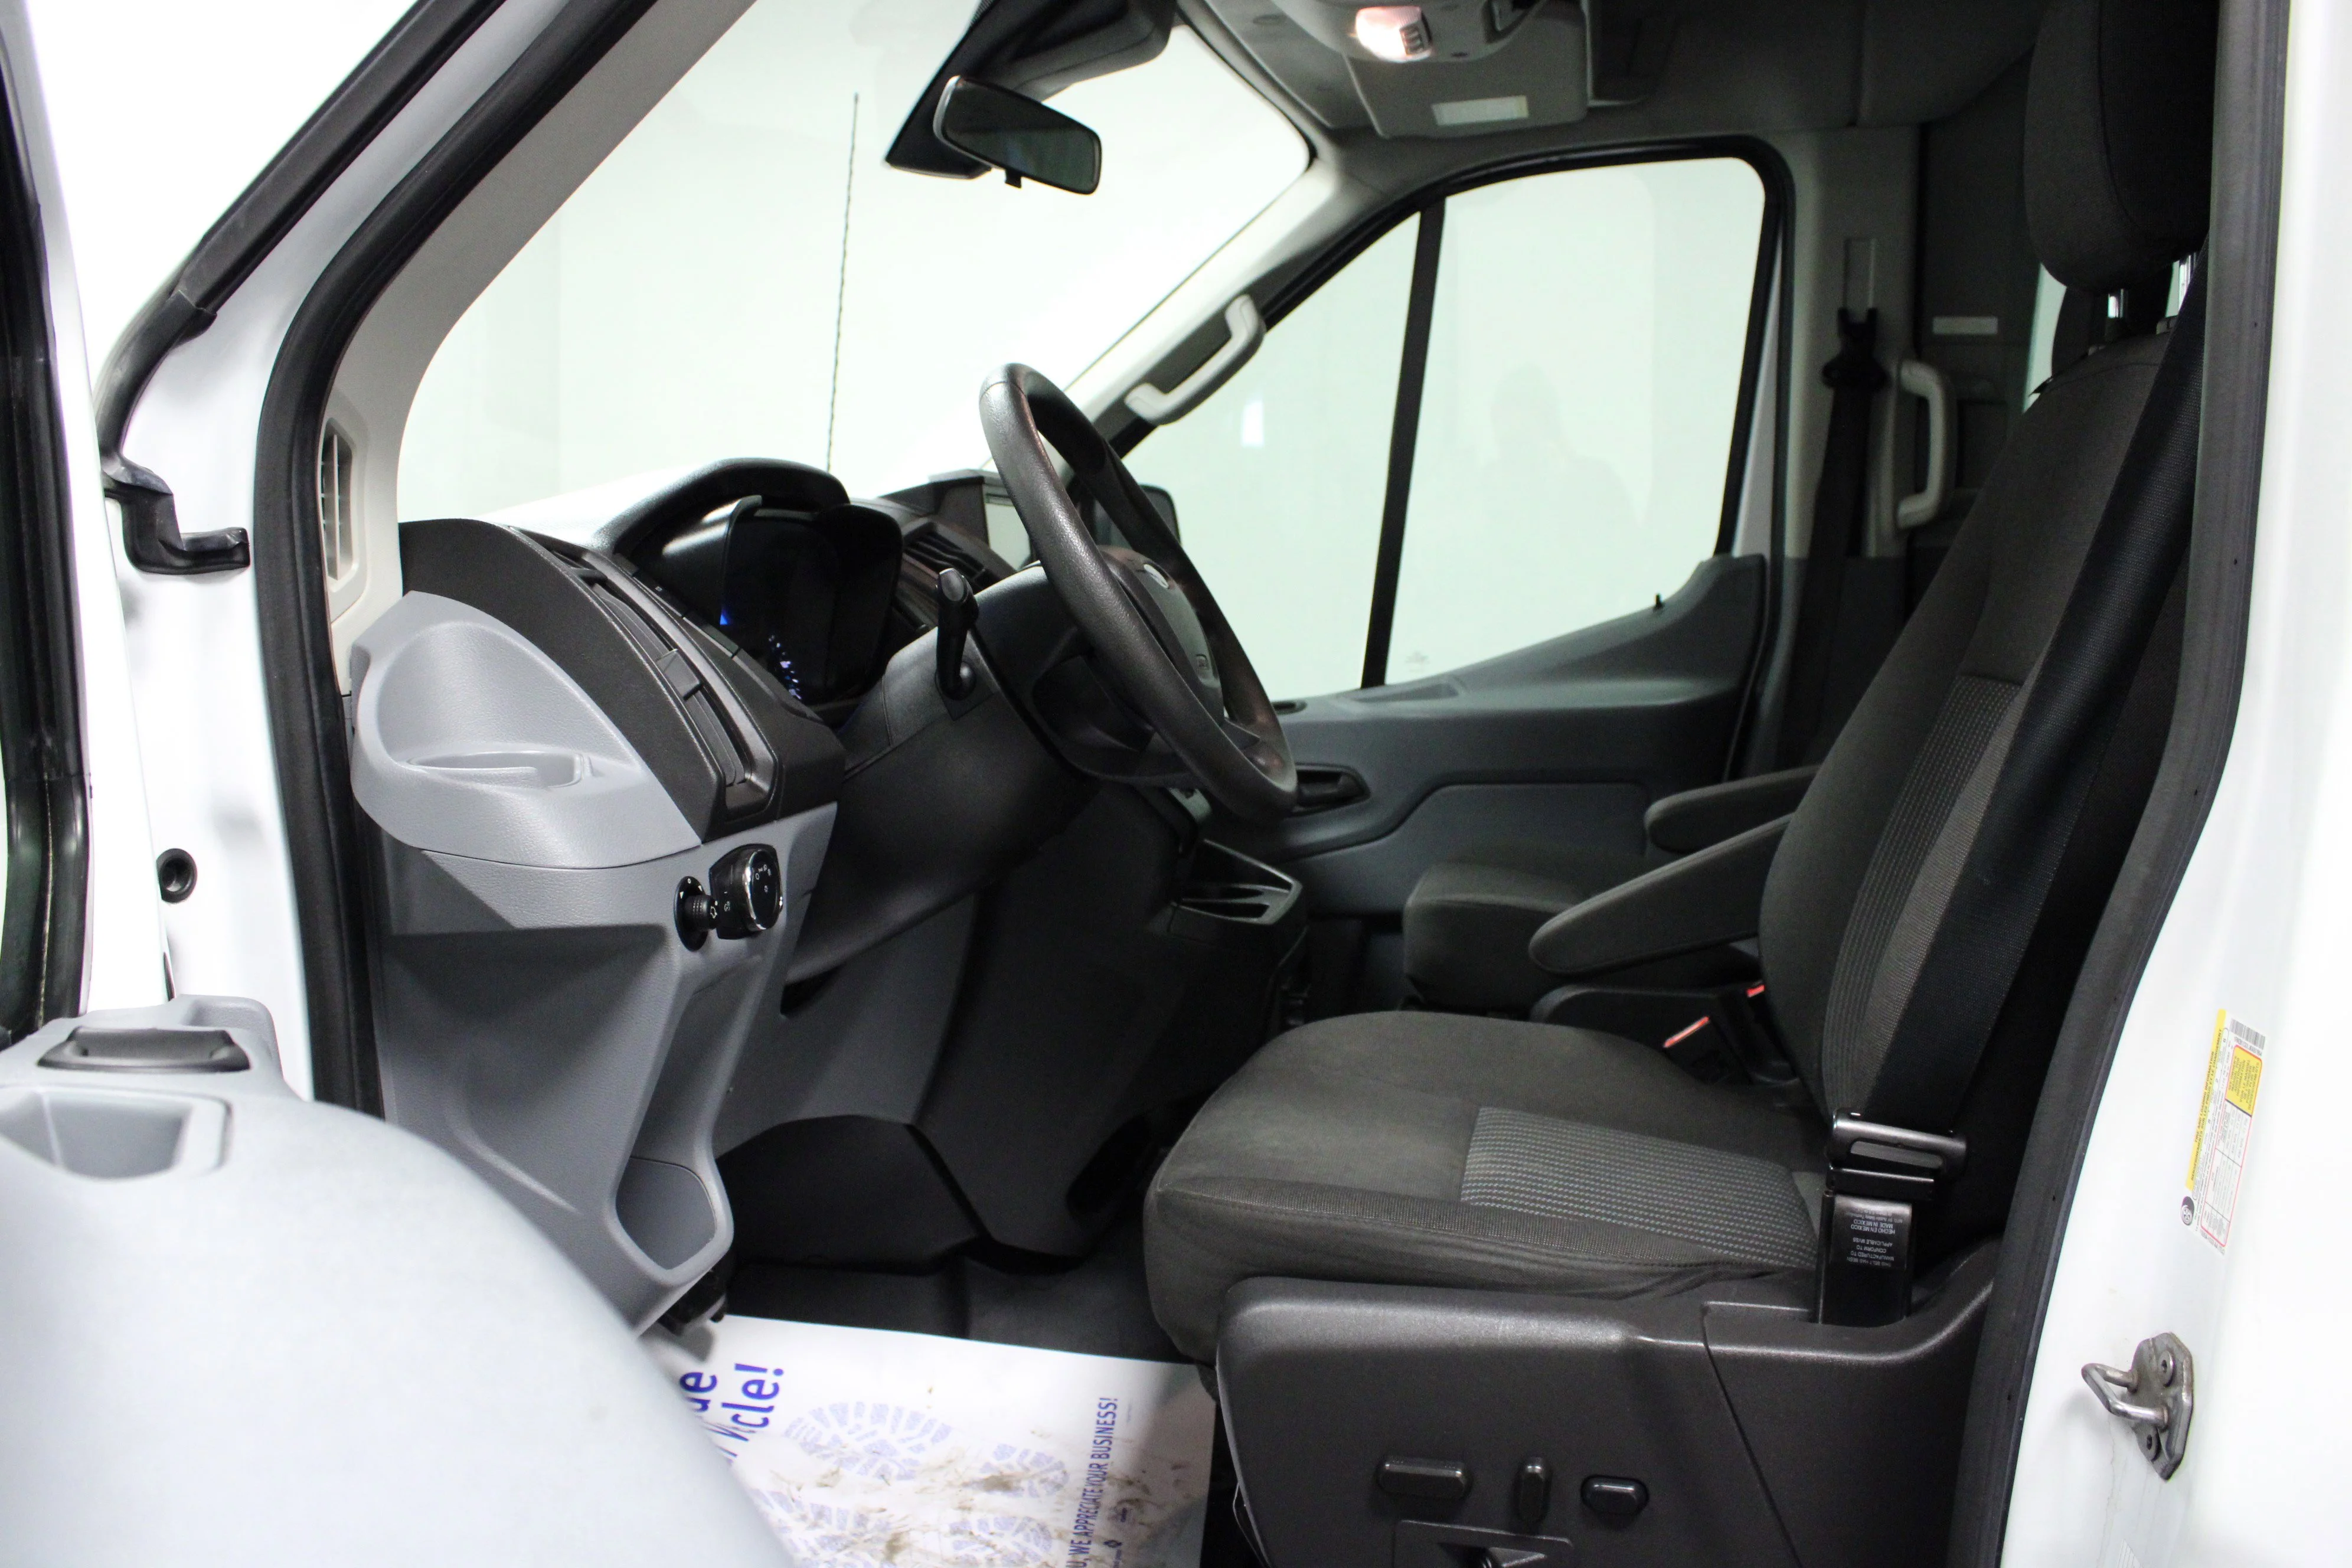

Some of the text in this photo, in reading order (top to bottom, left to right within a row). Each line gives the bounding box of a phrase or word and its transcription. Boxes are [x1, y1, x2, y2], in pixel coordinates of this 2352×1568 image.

[1090, 1397, 1118, 1459] BUSINESS!
[1084, 1463, 1109, 1486] YOUR
[1072, 1488, 1103, 1538] APPRECIATE
[1068, 1539, 1092, 1555] WE
